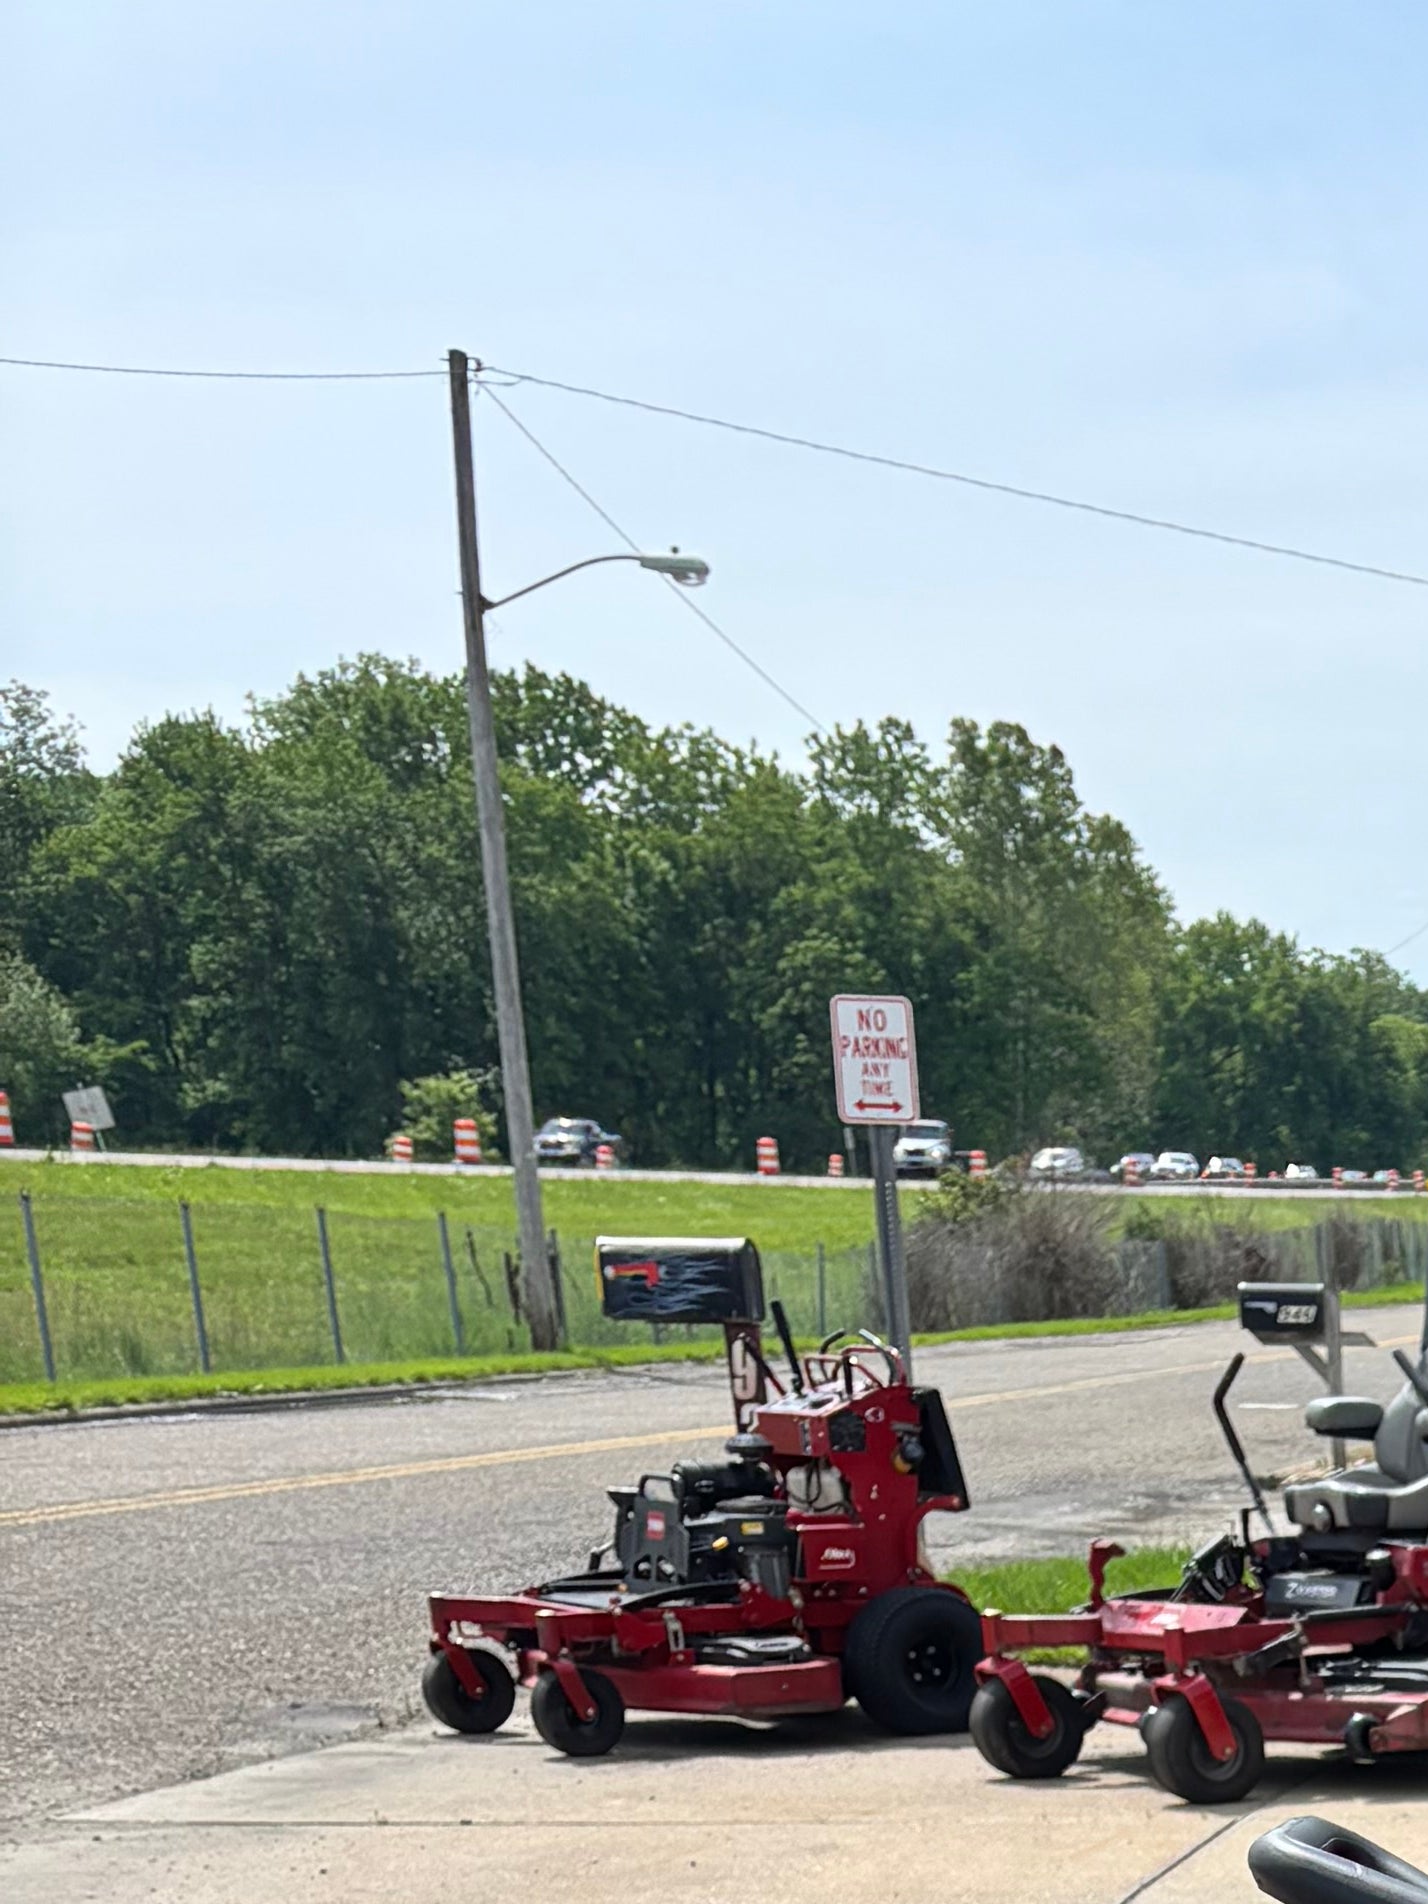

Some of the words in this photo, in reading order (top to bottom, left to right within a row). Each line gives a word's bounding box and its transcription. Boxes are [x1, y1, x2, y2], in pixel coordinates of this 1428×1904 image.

[857, 1008, 888, 1033] NO
[840, 1034, 908, 1060] PARKING
[861, 1062, 890, 1078] ANY
